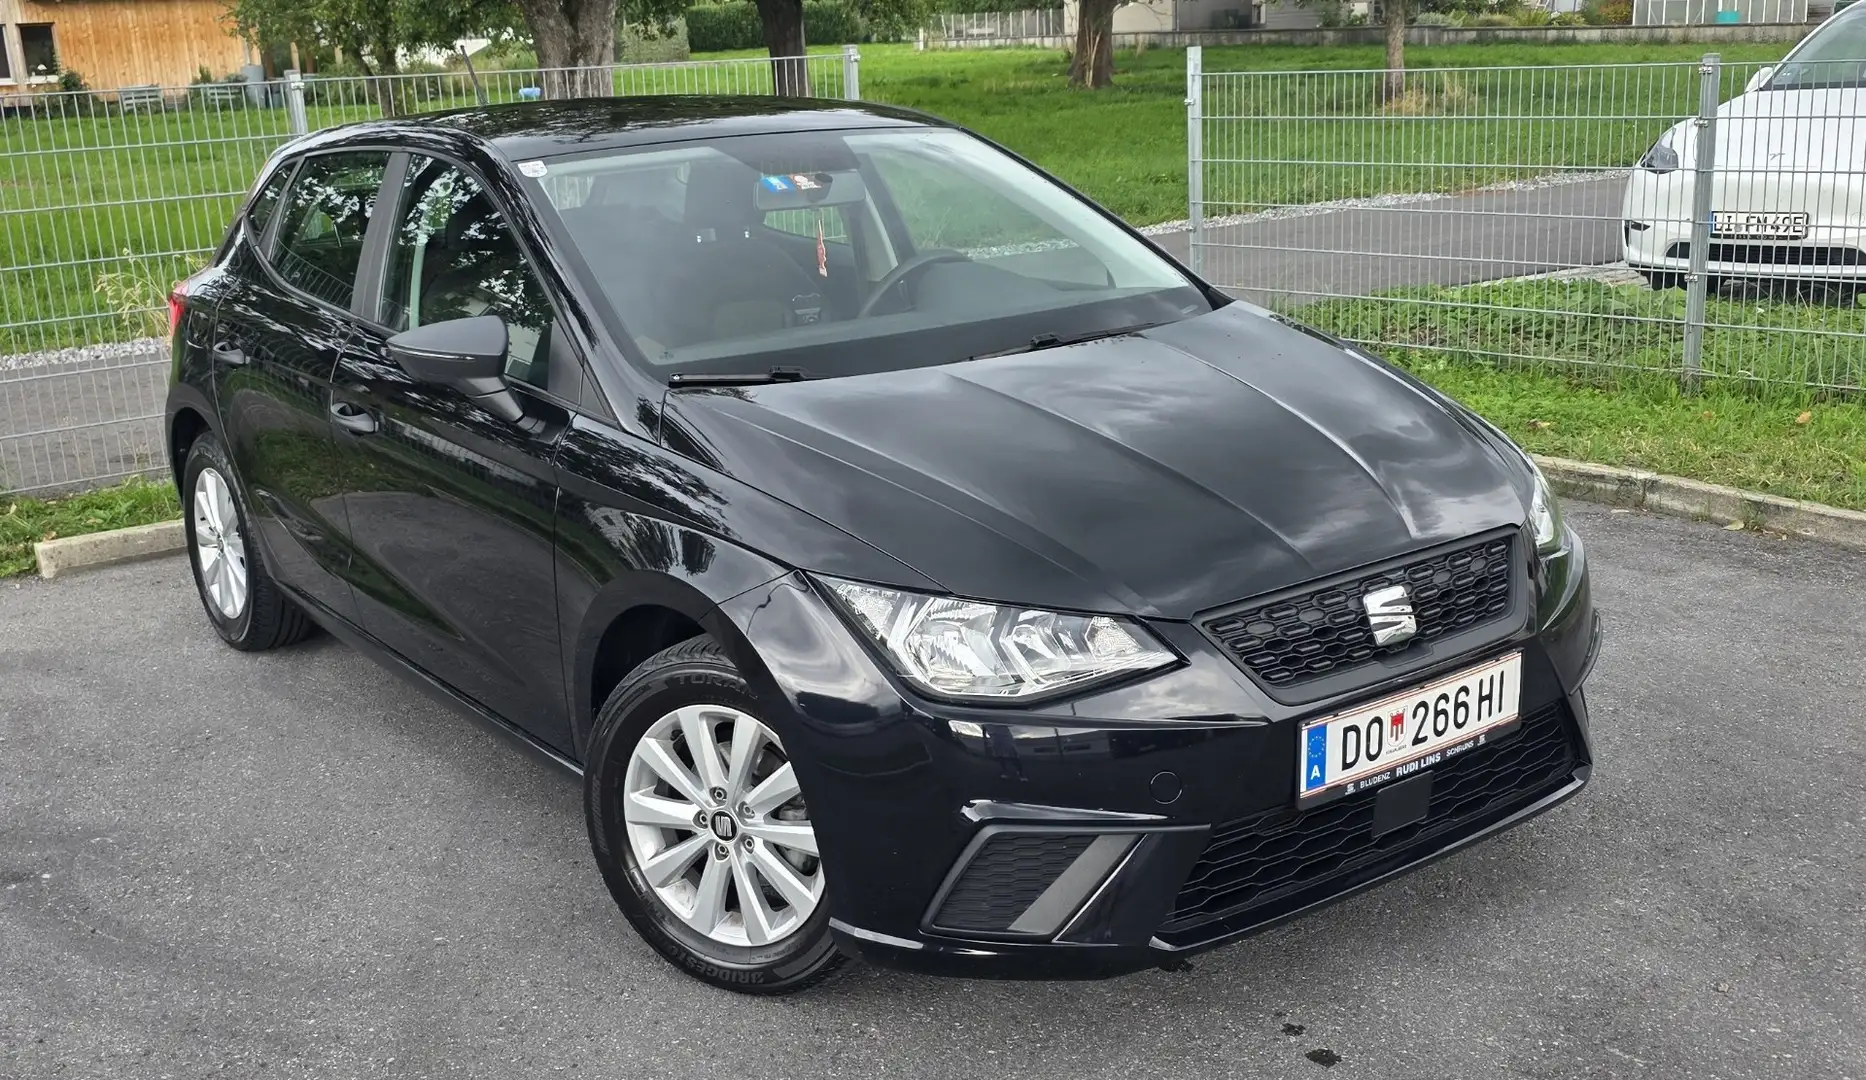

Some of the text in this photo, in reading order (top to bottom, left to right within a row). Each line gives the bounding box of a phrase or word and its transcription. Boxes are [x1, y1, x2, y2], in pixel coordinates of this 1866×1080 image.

[1714, 215, 1733, 232] LI
[1342, 670, 1505, 771] DO 266 HI
[1310, 765, 1321, 780] A
[1360, 772, 1390, 788] BLUDENZ
[1396, 761, 1418, 777] RUDI
[1421, 752, 1441, 768] LINS
[648, 925, 765, 984] BRIDGESTO
